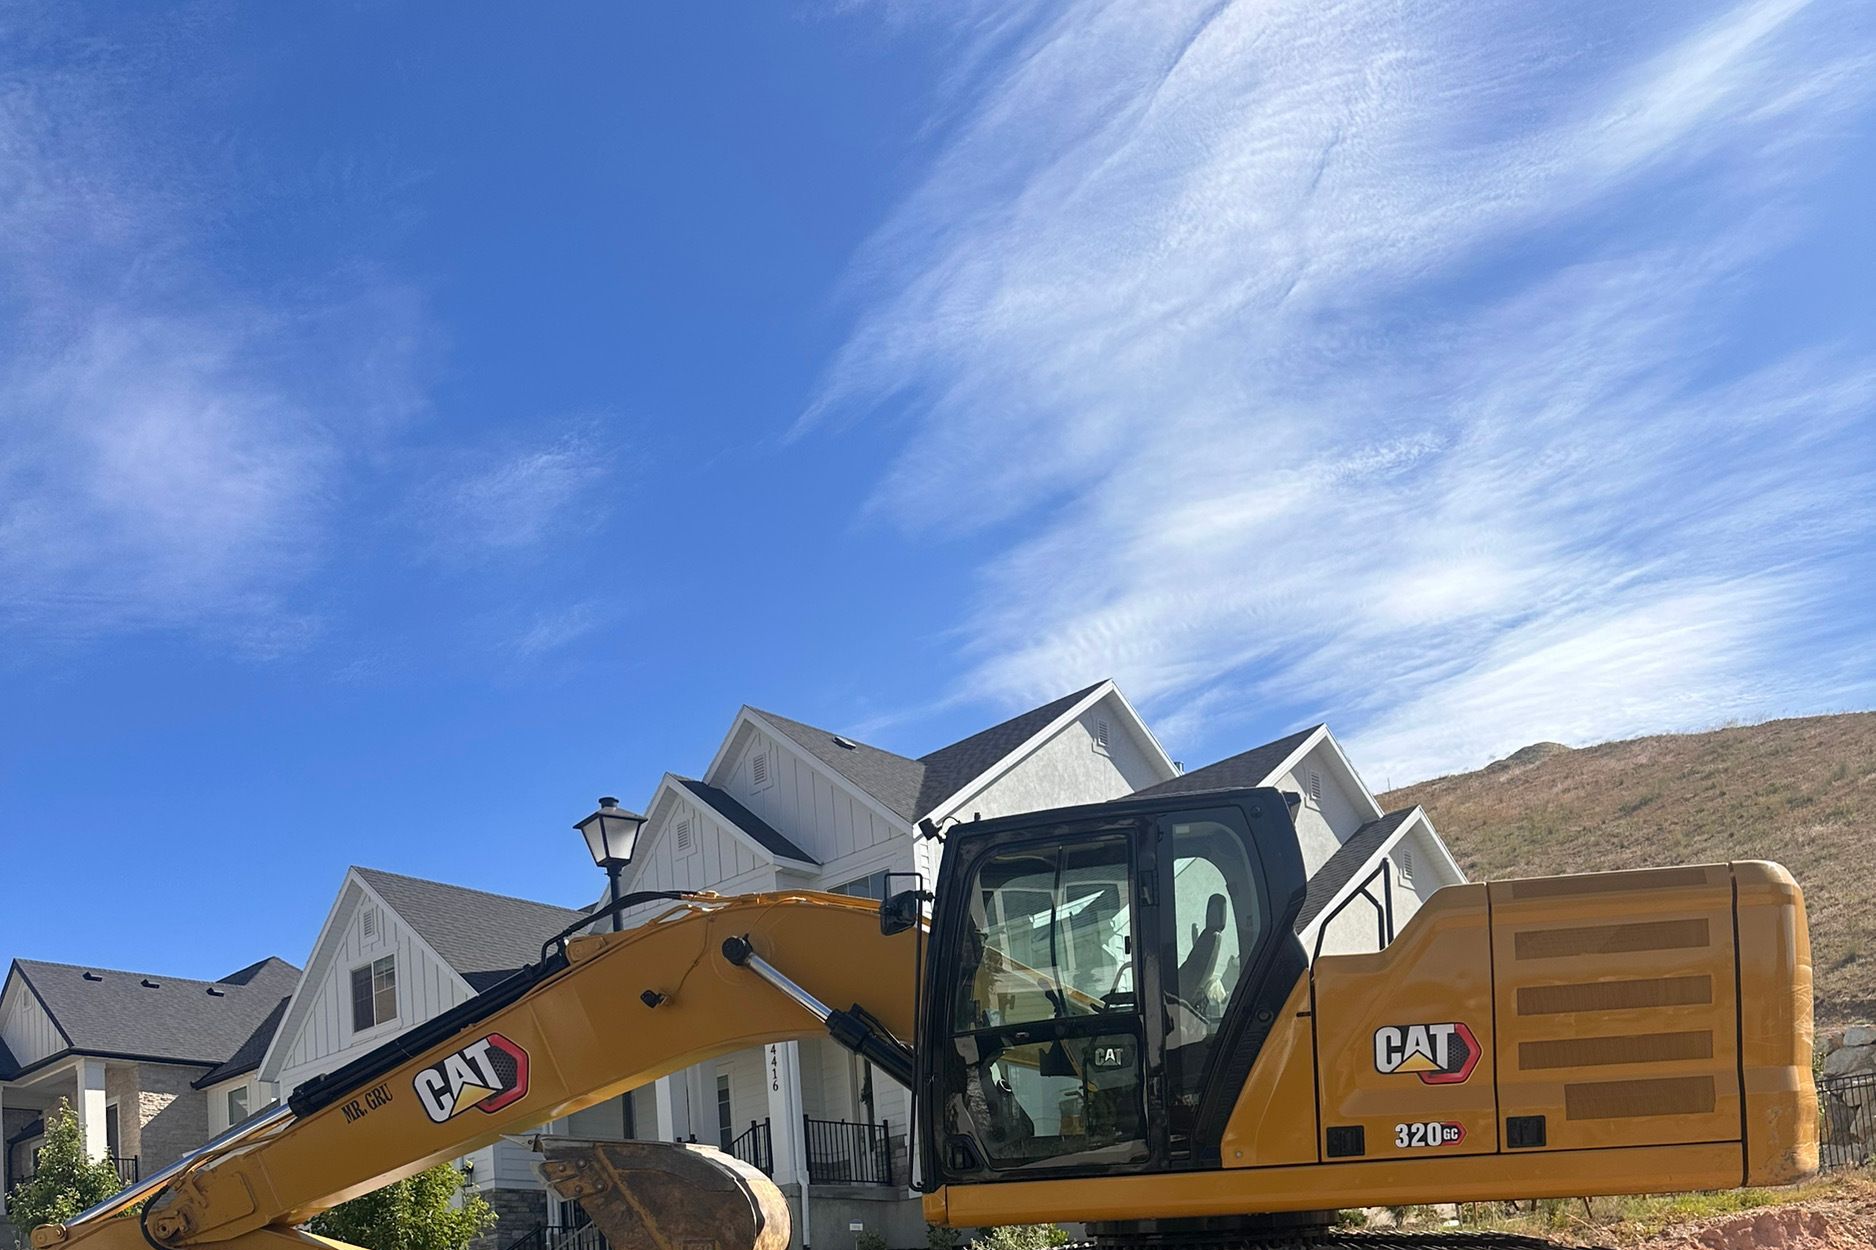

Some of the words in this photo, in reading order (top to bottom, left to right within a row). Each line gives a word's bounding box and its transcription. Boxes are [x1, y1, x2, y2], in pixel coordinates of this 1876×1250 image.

[770, 1044, 779, 1092] 4416
[1095, 1048, 1123, 1066] CAT
[1375, 1023, 1455, 1073] CAT
[365, 1083, 393, 1110] GRU
[413, 1038, 503, 1123] CAT
